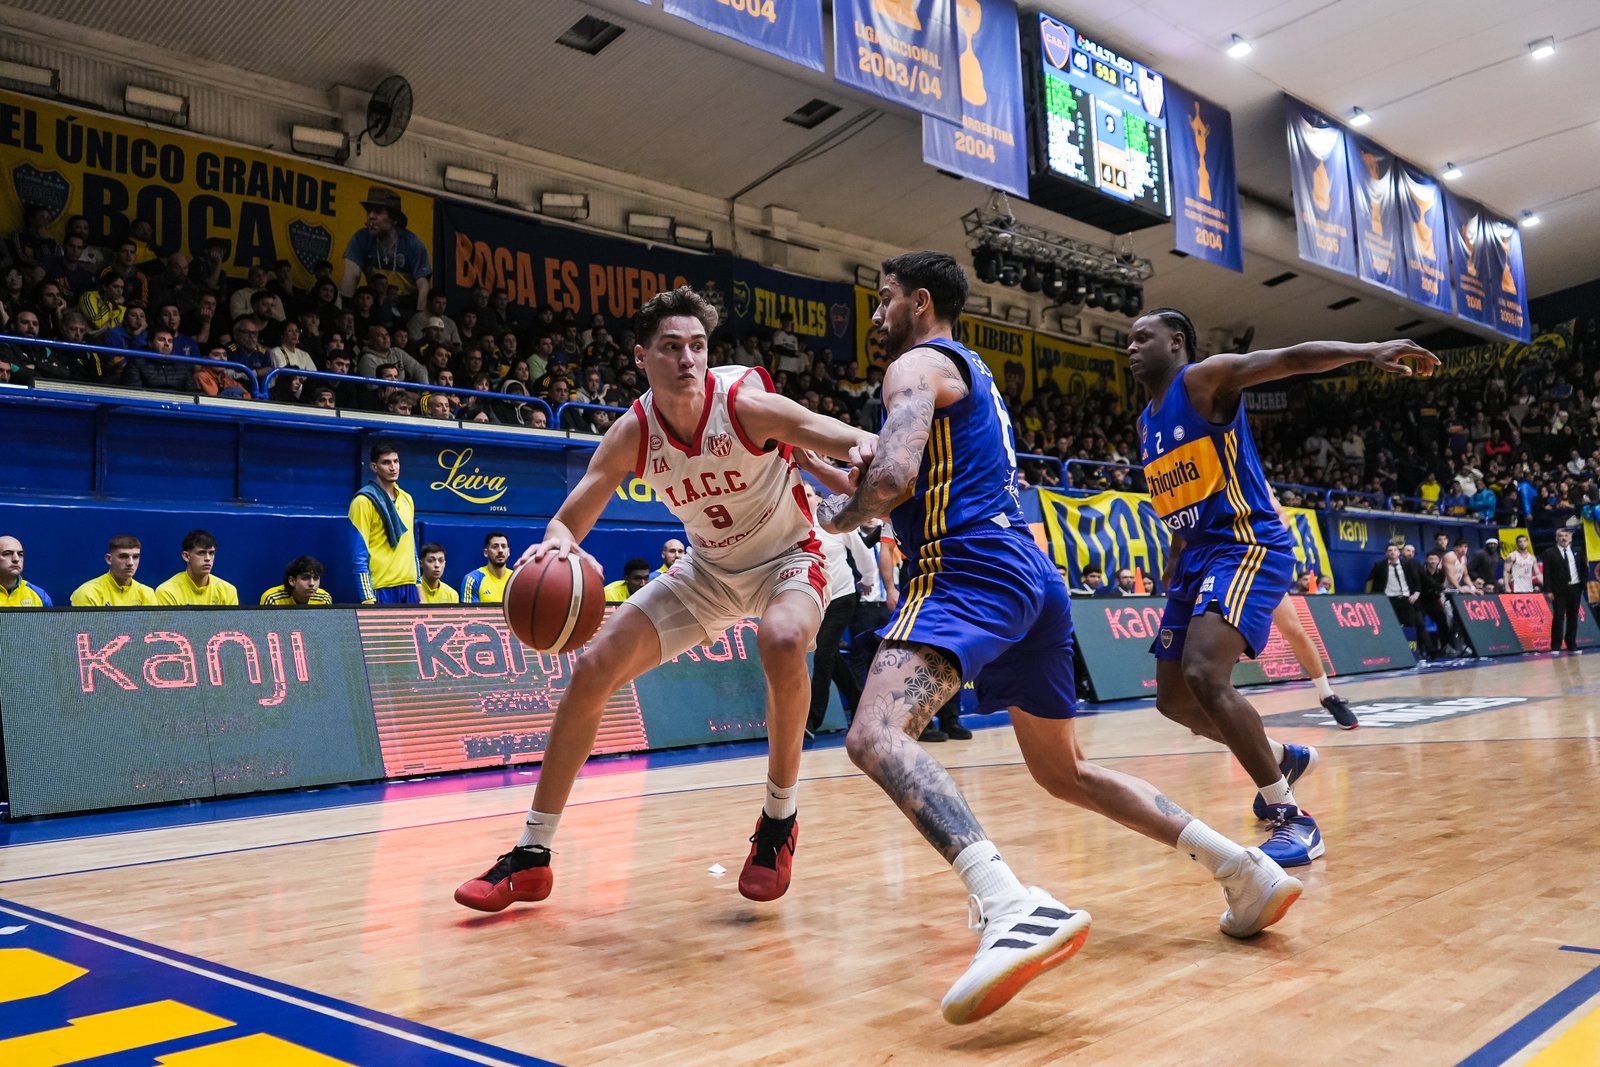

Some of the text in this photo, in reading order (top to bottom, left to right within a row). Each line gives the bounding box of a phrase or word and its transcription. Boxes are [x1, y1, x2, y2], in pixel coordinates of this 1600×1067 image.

[717, 0, 777, 24] 004
[858, 46, 942, 100] 2003/04
[0, 105, 337, 217] EL ÚNICO GRANDE
[954, 130, 996, 164] 2004
[82, 171, 279, 268] BOCA
[1195, 226, 1223, 252] 2004
[454, 230, 537, 308] BOCA
[544, 256, 581, 315] ES
[753, 287, 827, 337] FILIALES
[973, 323, 1024, 357] LIBRES
[1155, 431, 1165, 455] 2
[430, 447, 508, 504] Leiva
[703, 504, 734, 530] 9
[1338, 520, 1369, 550] kanji
[1104, 606, 1165, 640] kan
[1331, 601, 1381, 636] kanji
[1463, 599, 1501, 628] kanji
[76, 631, 310, 706] kanji
